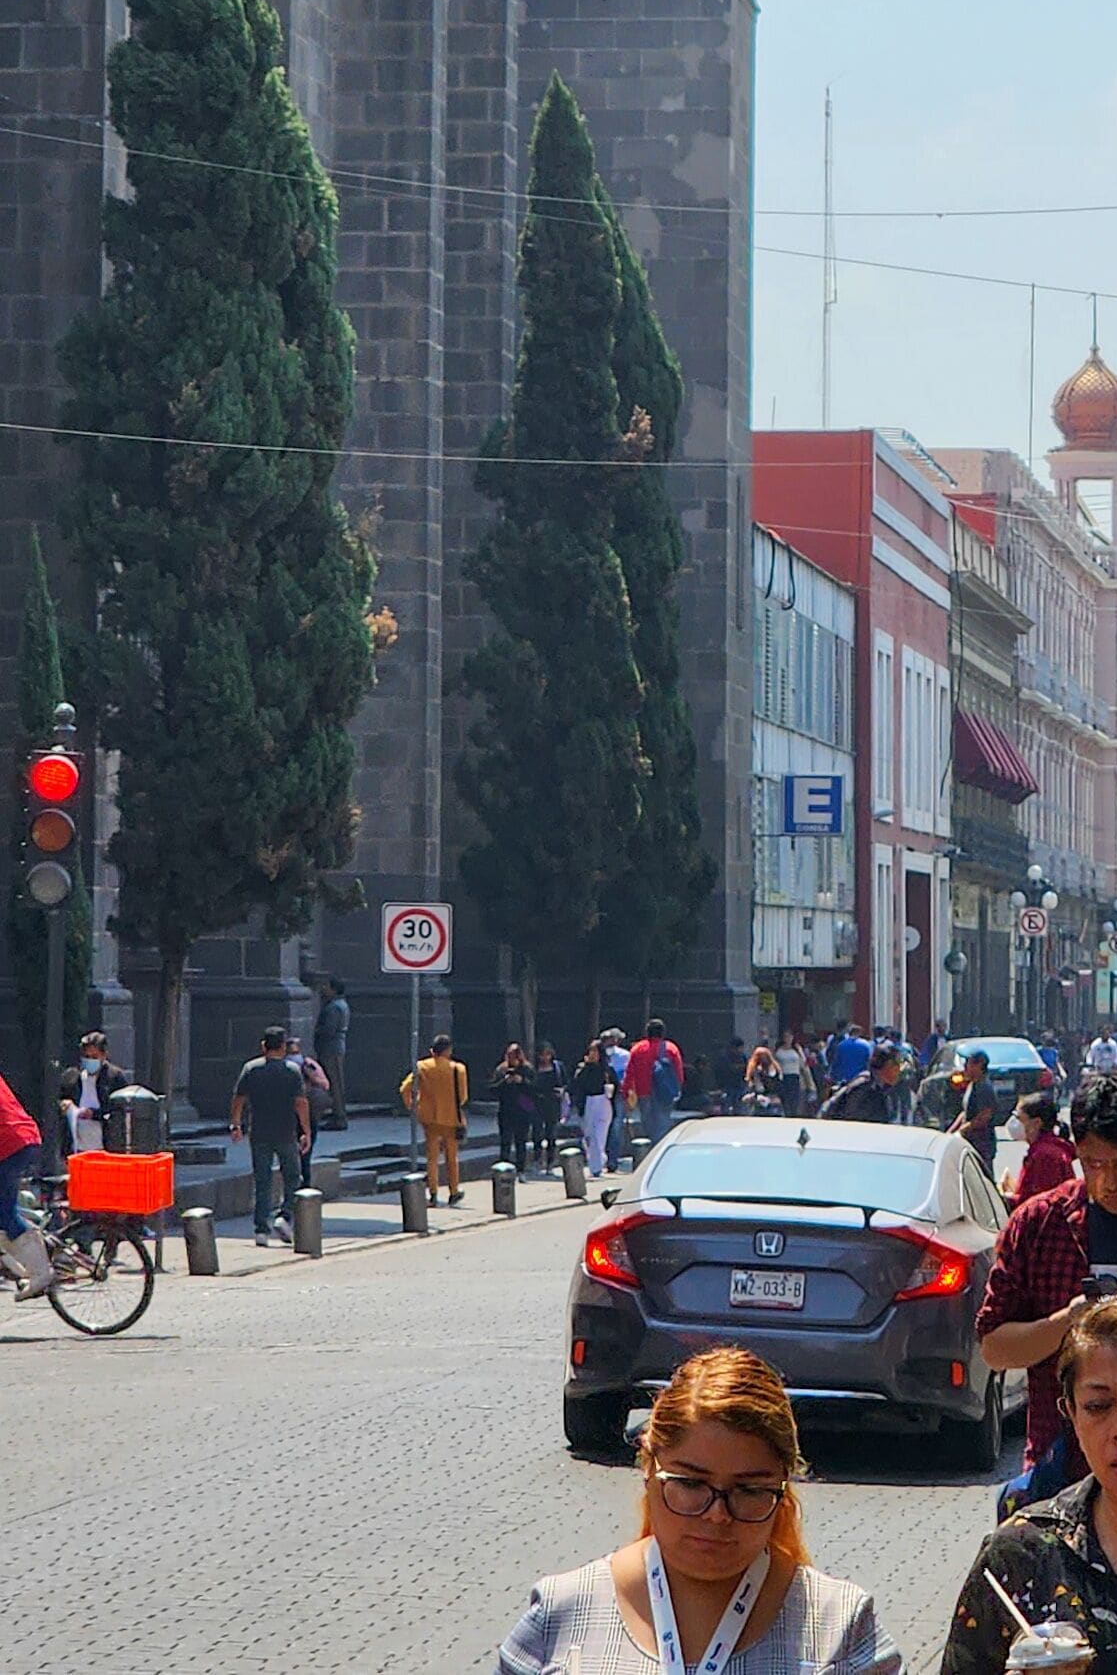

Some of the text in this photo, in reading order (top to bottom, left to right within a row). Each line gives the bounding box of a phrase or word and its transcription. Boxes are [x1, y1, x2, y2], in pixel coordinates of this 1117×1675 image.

[793, 777, 833, 824] E
[403, 919, 433, 939] 30
[398, 942, 434, 952] km/h
